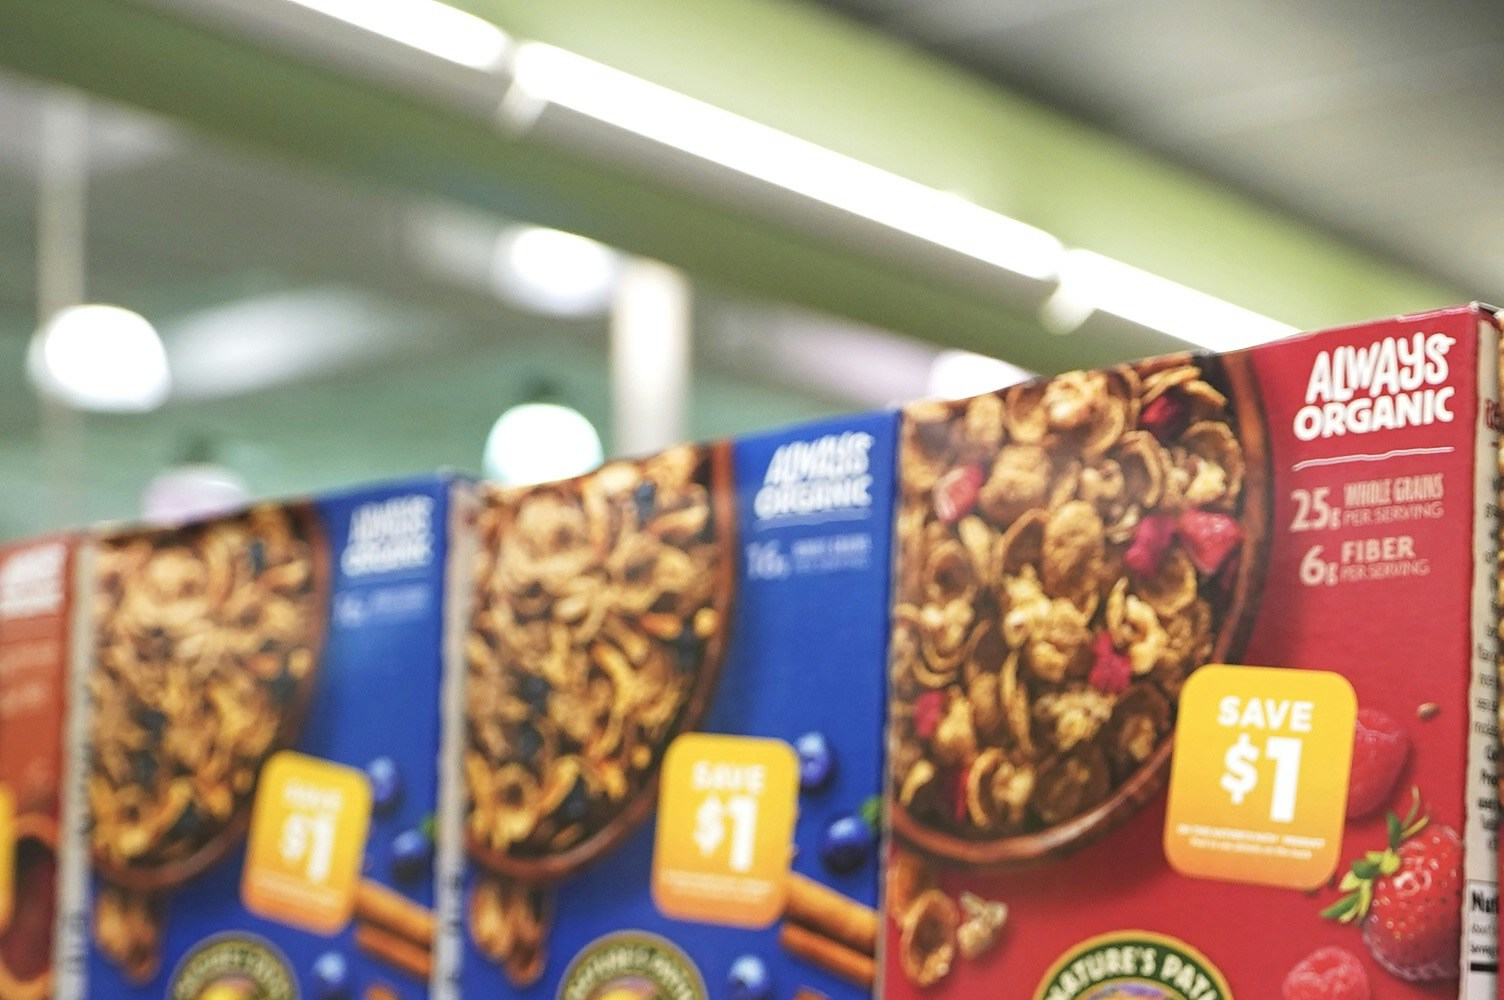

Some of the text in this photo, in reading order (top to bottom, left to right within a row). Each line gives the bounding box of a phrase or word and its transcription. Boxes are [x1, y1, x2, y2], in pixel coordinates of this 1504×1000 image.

[1305, 332, 1456, 404] ALWAYS
[1293, 386, 1455, 441] ORGANIC
[1341, 536, 1415, 563] FIBER
[1217, 695, 1314, 732] SAVE
[1220, 732, 1303, 824] $1
